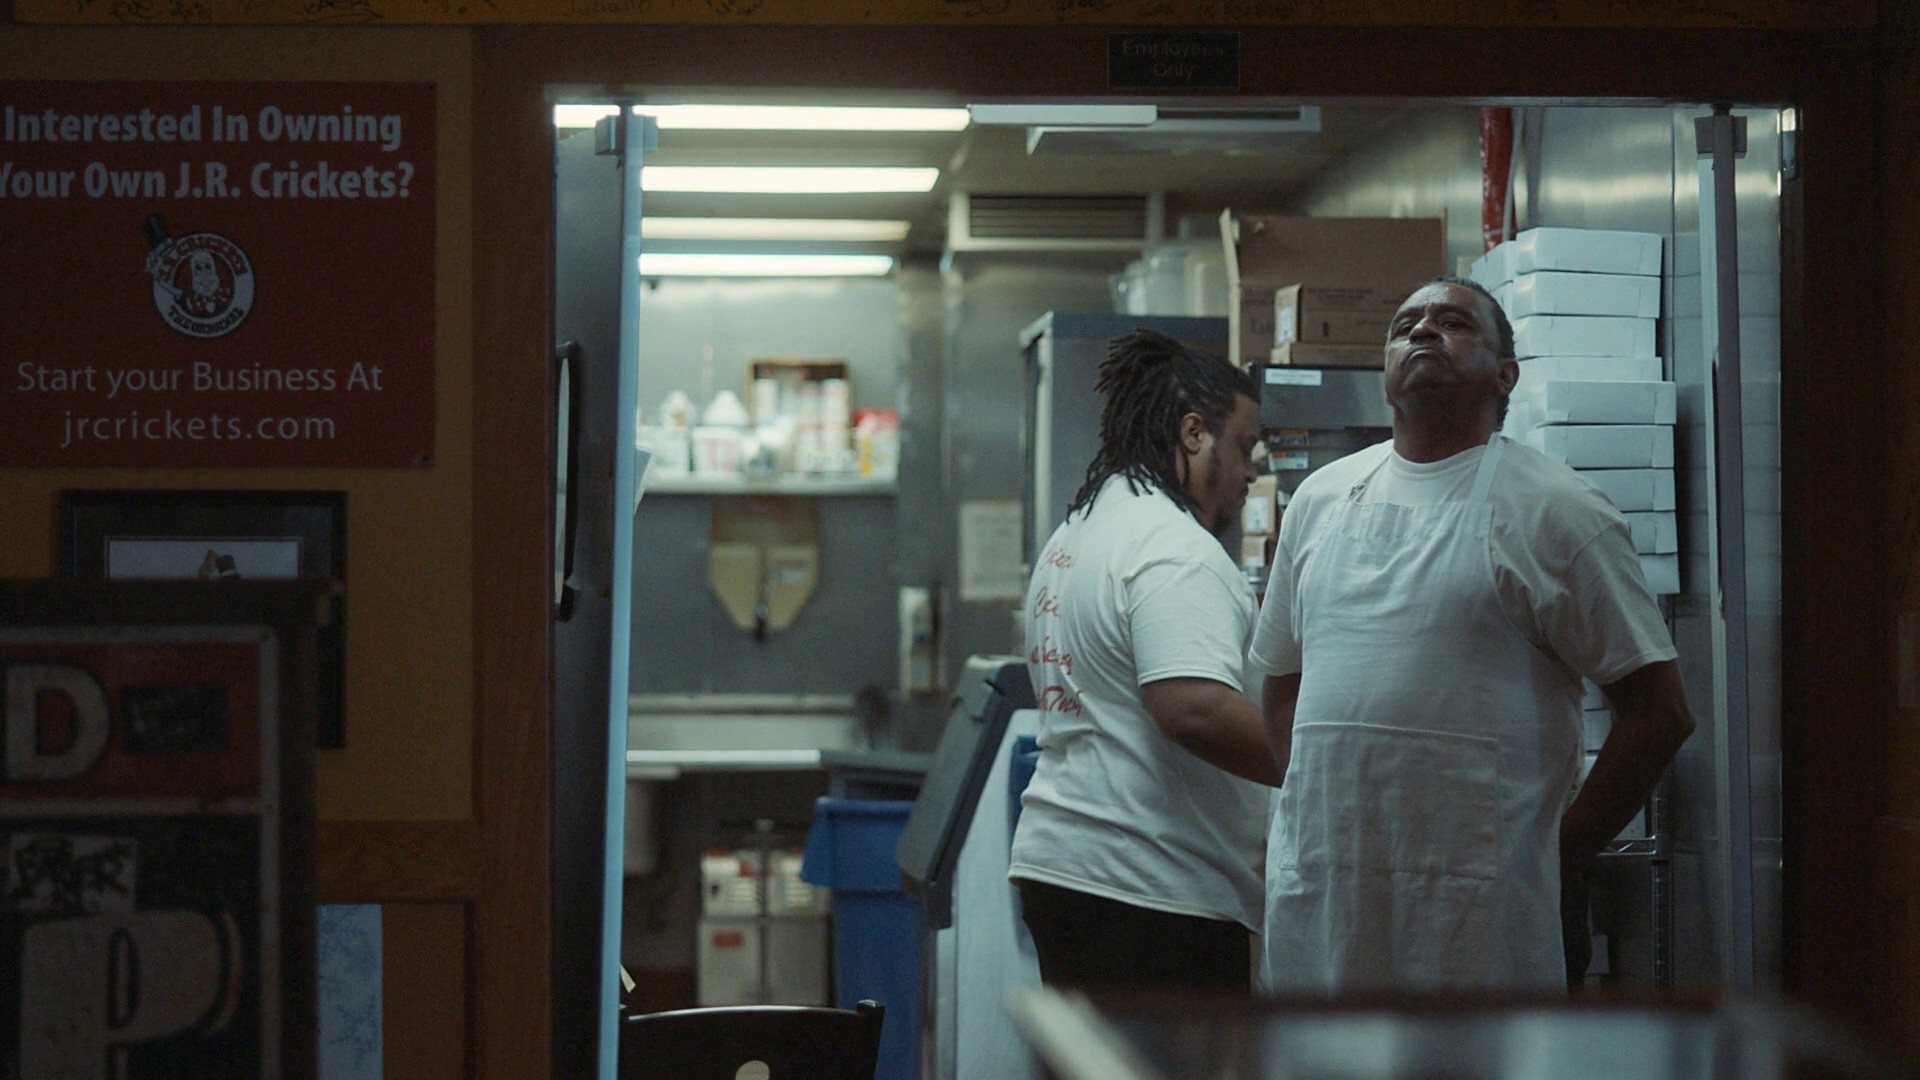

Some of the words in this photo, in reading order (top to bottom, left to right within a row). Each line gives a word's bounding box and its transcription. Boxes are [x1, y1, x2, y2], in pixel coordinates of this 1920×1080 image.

[1152, 61, 1196, 80] Only
[4, 104, 202, 143] Interested
[212, 104, 250, 143] In
[258, 104, 403, 152] Owning
[0, 161, 76, 199] Your
[84, 161, 167, 199] Own
[174, 161, 242, 199] J.R.
[250, 160, 415, 199] Crickets?
[16, 361, 97, 392] Start
[106, 368, 184, 399] your
[192, 361, 338, 392] Business
[346, 361, 384, 392] At
[60, 408, 337, 449] jrcrickets.com
